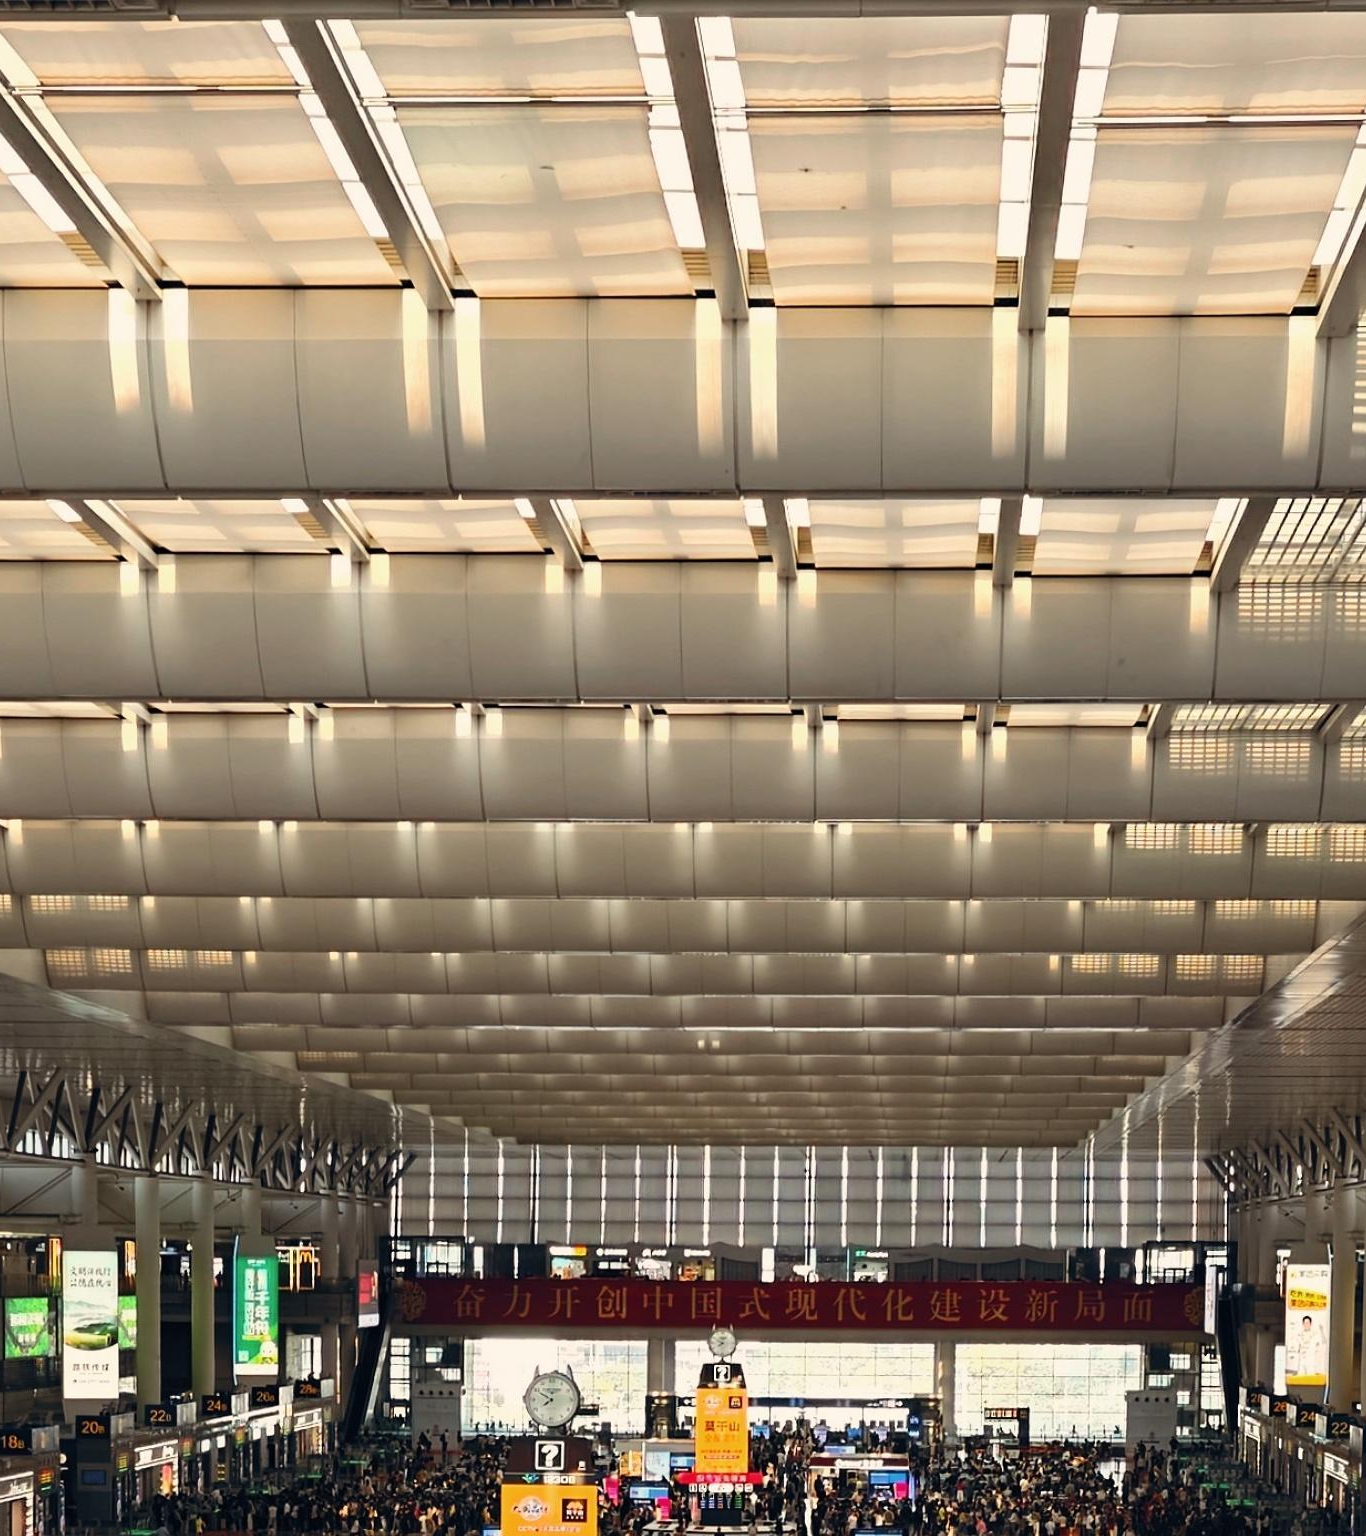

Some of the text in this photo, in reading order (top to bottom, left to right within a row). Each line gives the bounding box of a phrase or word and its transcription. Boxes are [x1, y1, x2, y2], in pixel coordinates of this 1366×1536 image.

[453, 1284, 1155, 1323] 奋力开创中国式现代化建设新局面
[0, 1435, 25, 1449] 18B
